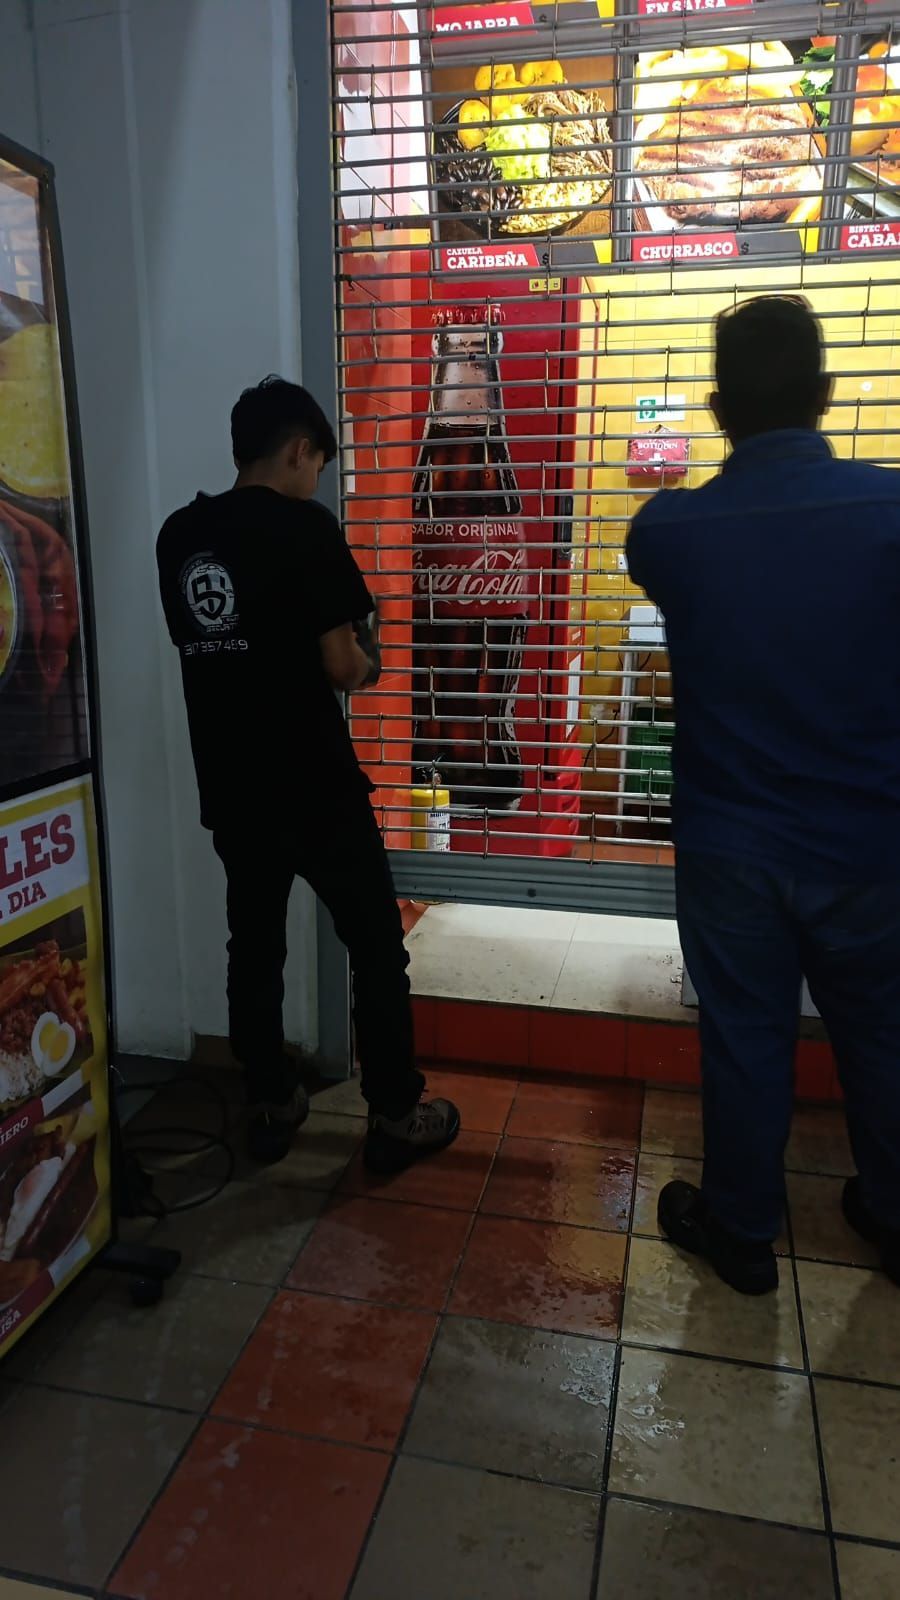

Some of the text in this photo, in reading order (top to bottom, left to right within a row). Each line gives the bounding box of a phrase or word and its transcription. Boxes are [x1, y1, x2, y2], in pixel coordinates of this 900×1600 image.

[849, 223, 890, 233] BISTEC A
[847, 233, 900, 248] CABA
[640, 242, 734, 259] CHURRASCO
[447, 251, 528, 269] CARIBEÑA
[458, 522, 519, 537] ORIGINAL
[8, 881, 46, 914] DIA
